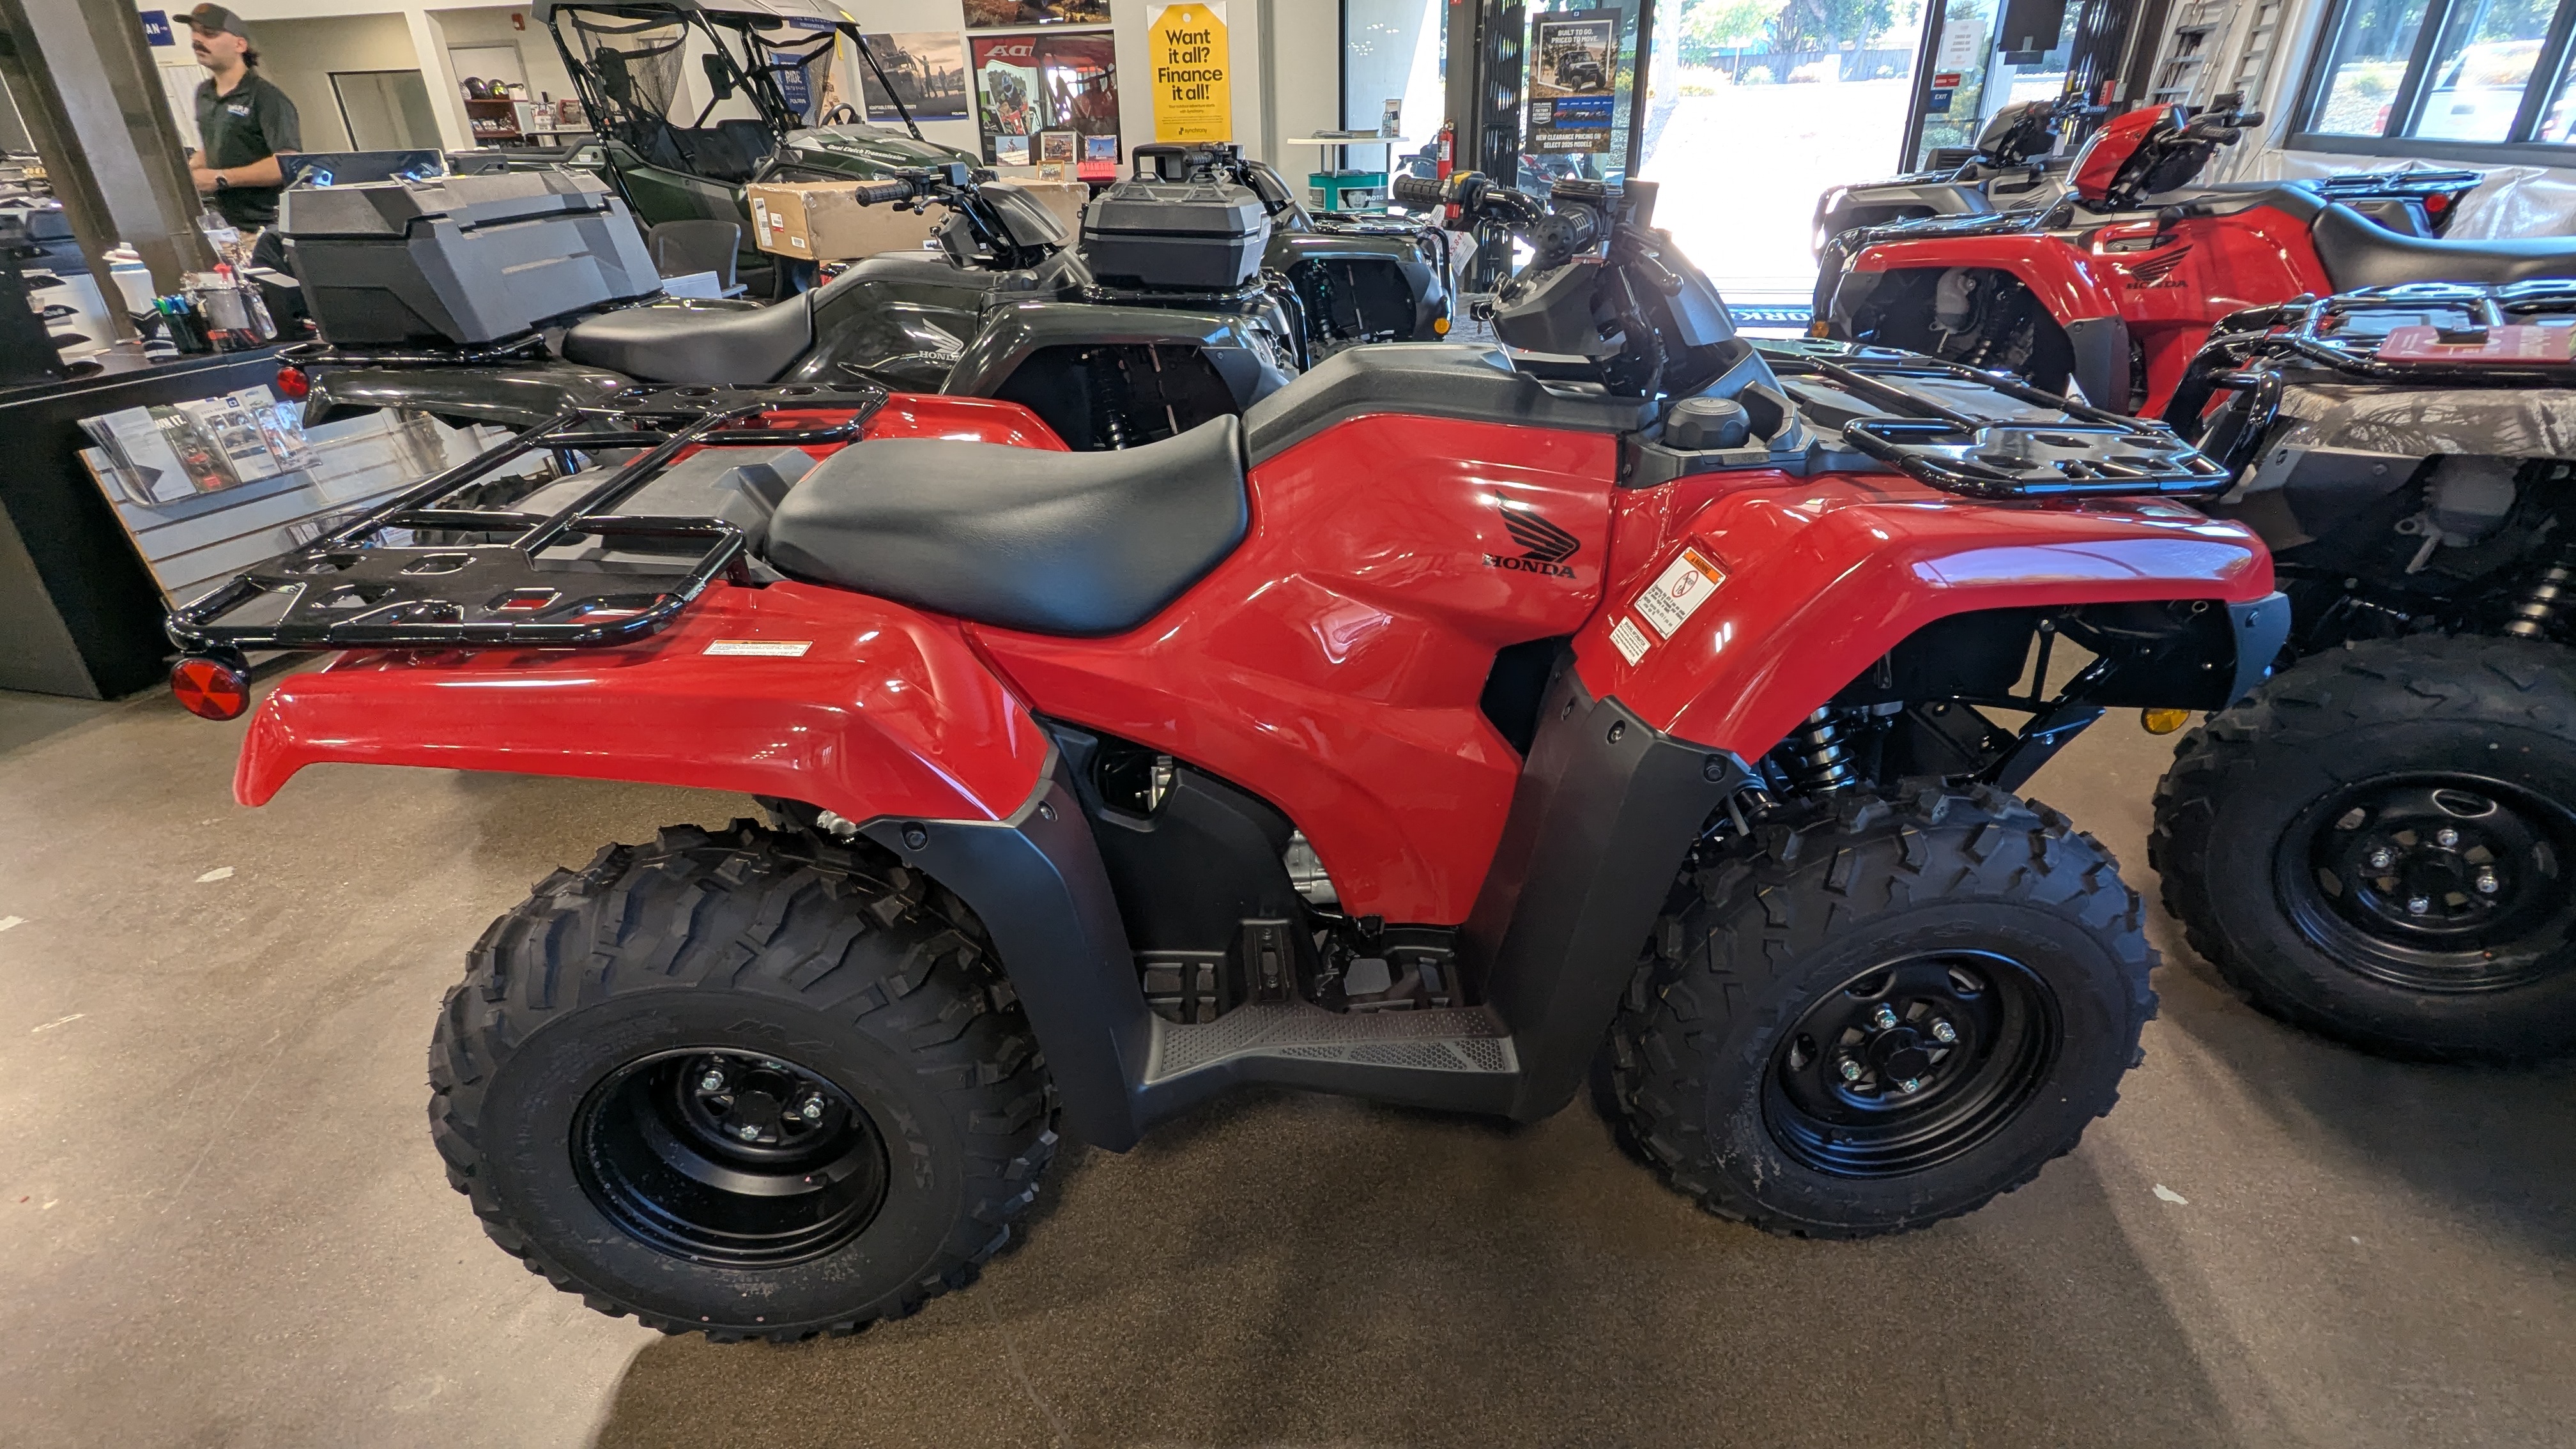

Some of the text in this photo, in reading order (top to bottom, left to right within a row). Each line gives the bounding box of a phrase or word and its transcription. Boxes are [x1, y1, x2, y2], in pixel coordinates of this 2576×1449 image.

[1165, 29, 1211, 45] Want
[1169, 47, 1210, 64] it all?
[1158, 67, 1223, 83] Finance
[1172, 84, 1209, 100] it all!
[843, 146, 864, 155] Clutch
[864, 149, 907, 162] Transmission
[1482, 552, 1577, 579] HONDA
